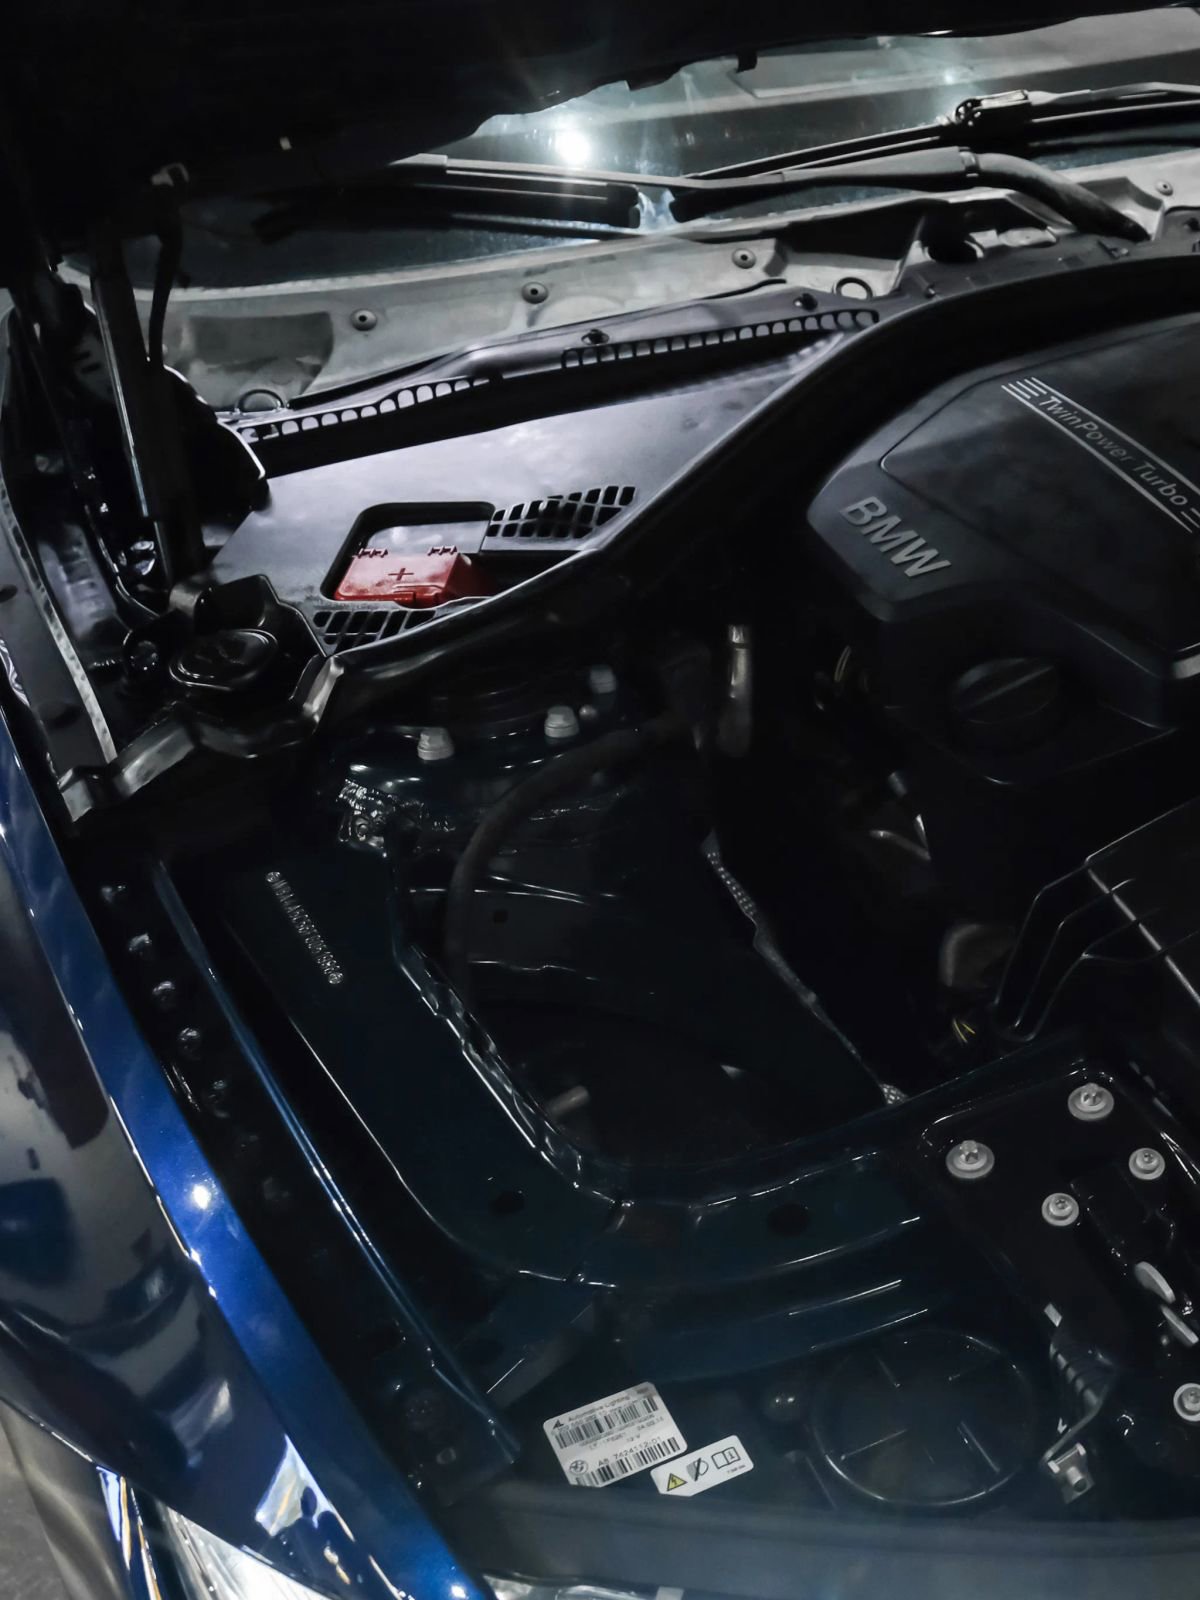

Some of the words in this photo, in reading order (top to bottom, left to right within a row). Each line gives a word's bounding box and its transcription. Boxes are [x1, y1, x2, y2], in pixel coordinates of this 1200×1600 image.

[1039, 397, 1134, 463] TwinPower
[1133, 462, 1188, 507] Turbo
[840, 496, 952, 578] BMW
